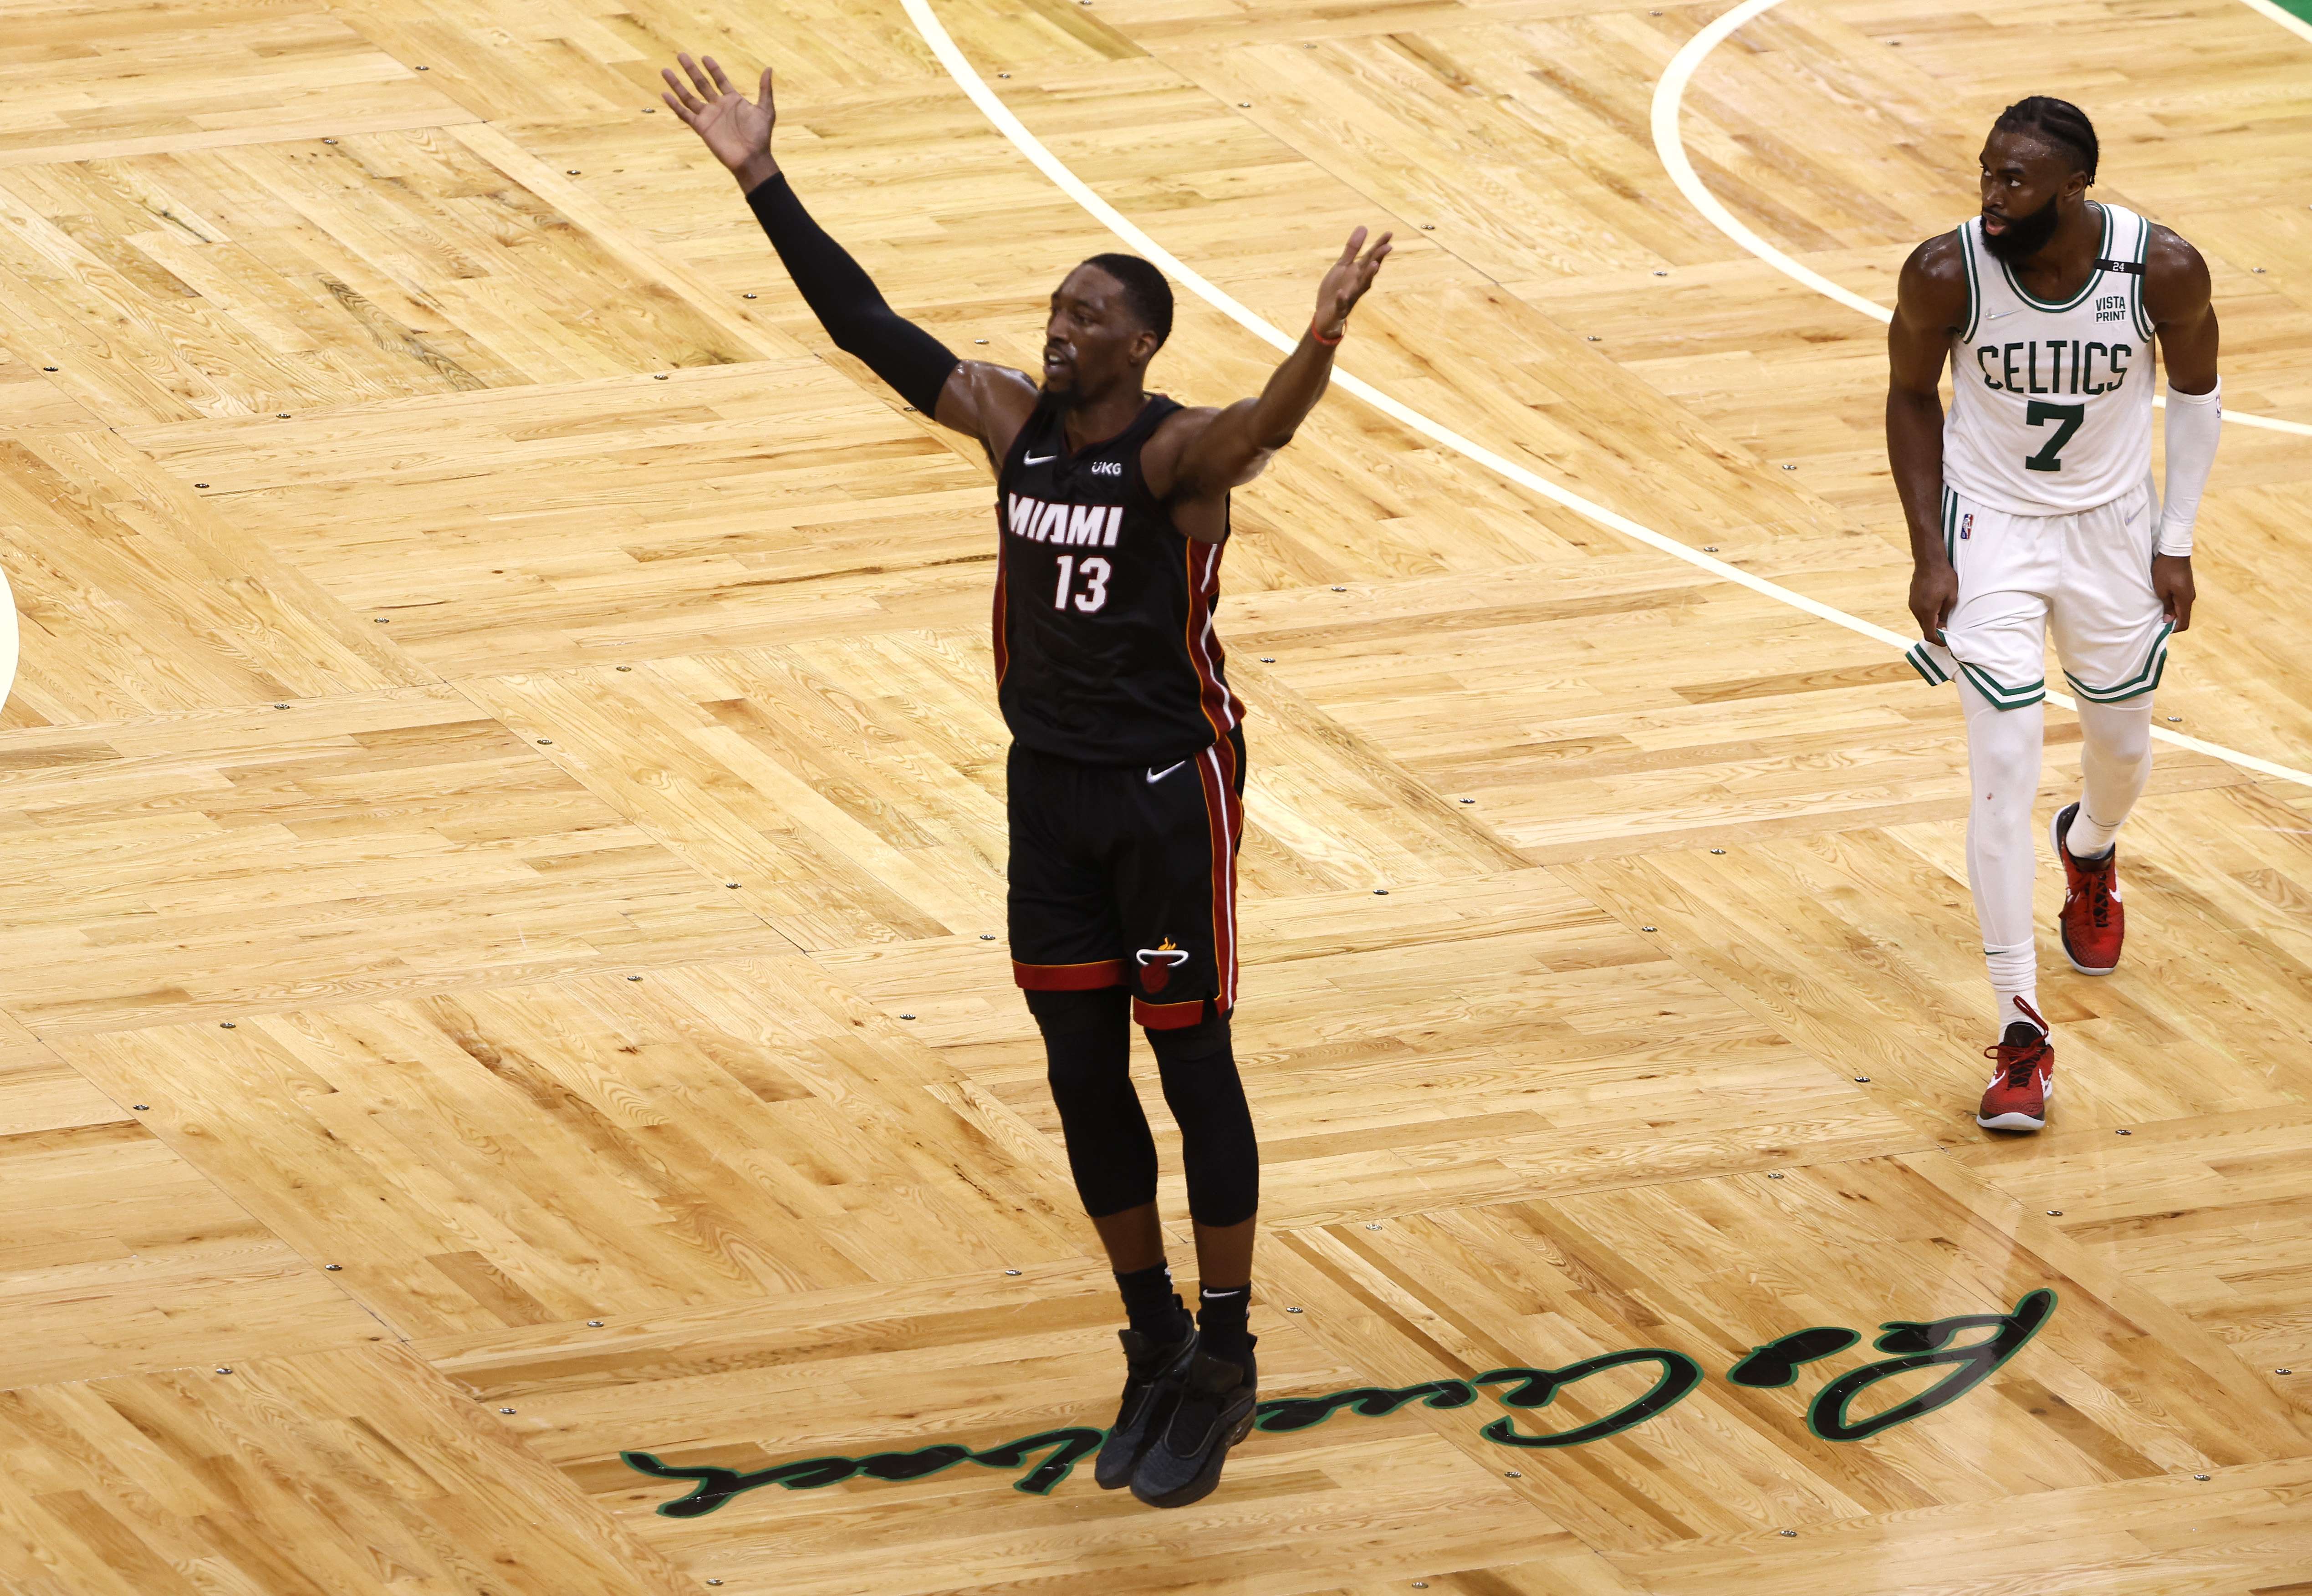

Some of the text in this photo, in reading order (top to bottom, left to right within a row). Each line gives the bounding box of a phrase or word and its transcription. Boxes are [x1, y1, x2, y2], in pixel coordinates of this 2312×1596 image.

[2113, 262, 2124, 272] 24
[2096, 296, 2125, 311] VISTA
[2096, 310, 2126, 322] PRINT
[1977, 341, 2132, 395] CELTICS
[2026, 400, 2084, 471] 7
[1008, 492, 1123, 546] MIAMI
[1054, 555, 1112, 612] 13
[620, 1348, 1705, 1518] Auebach
